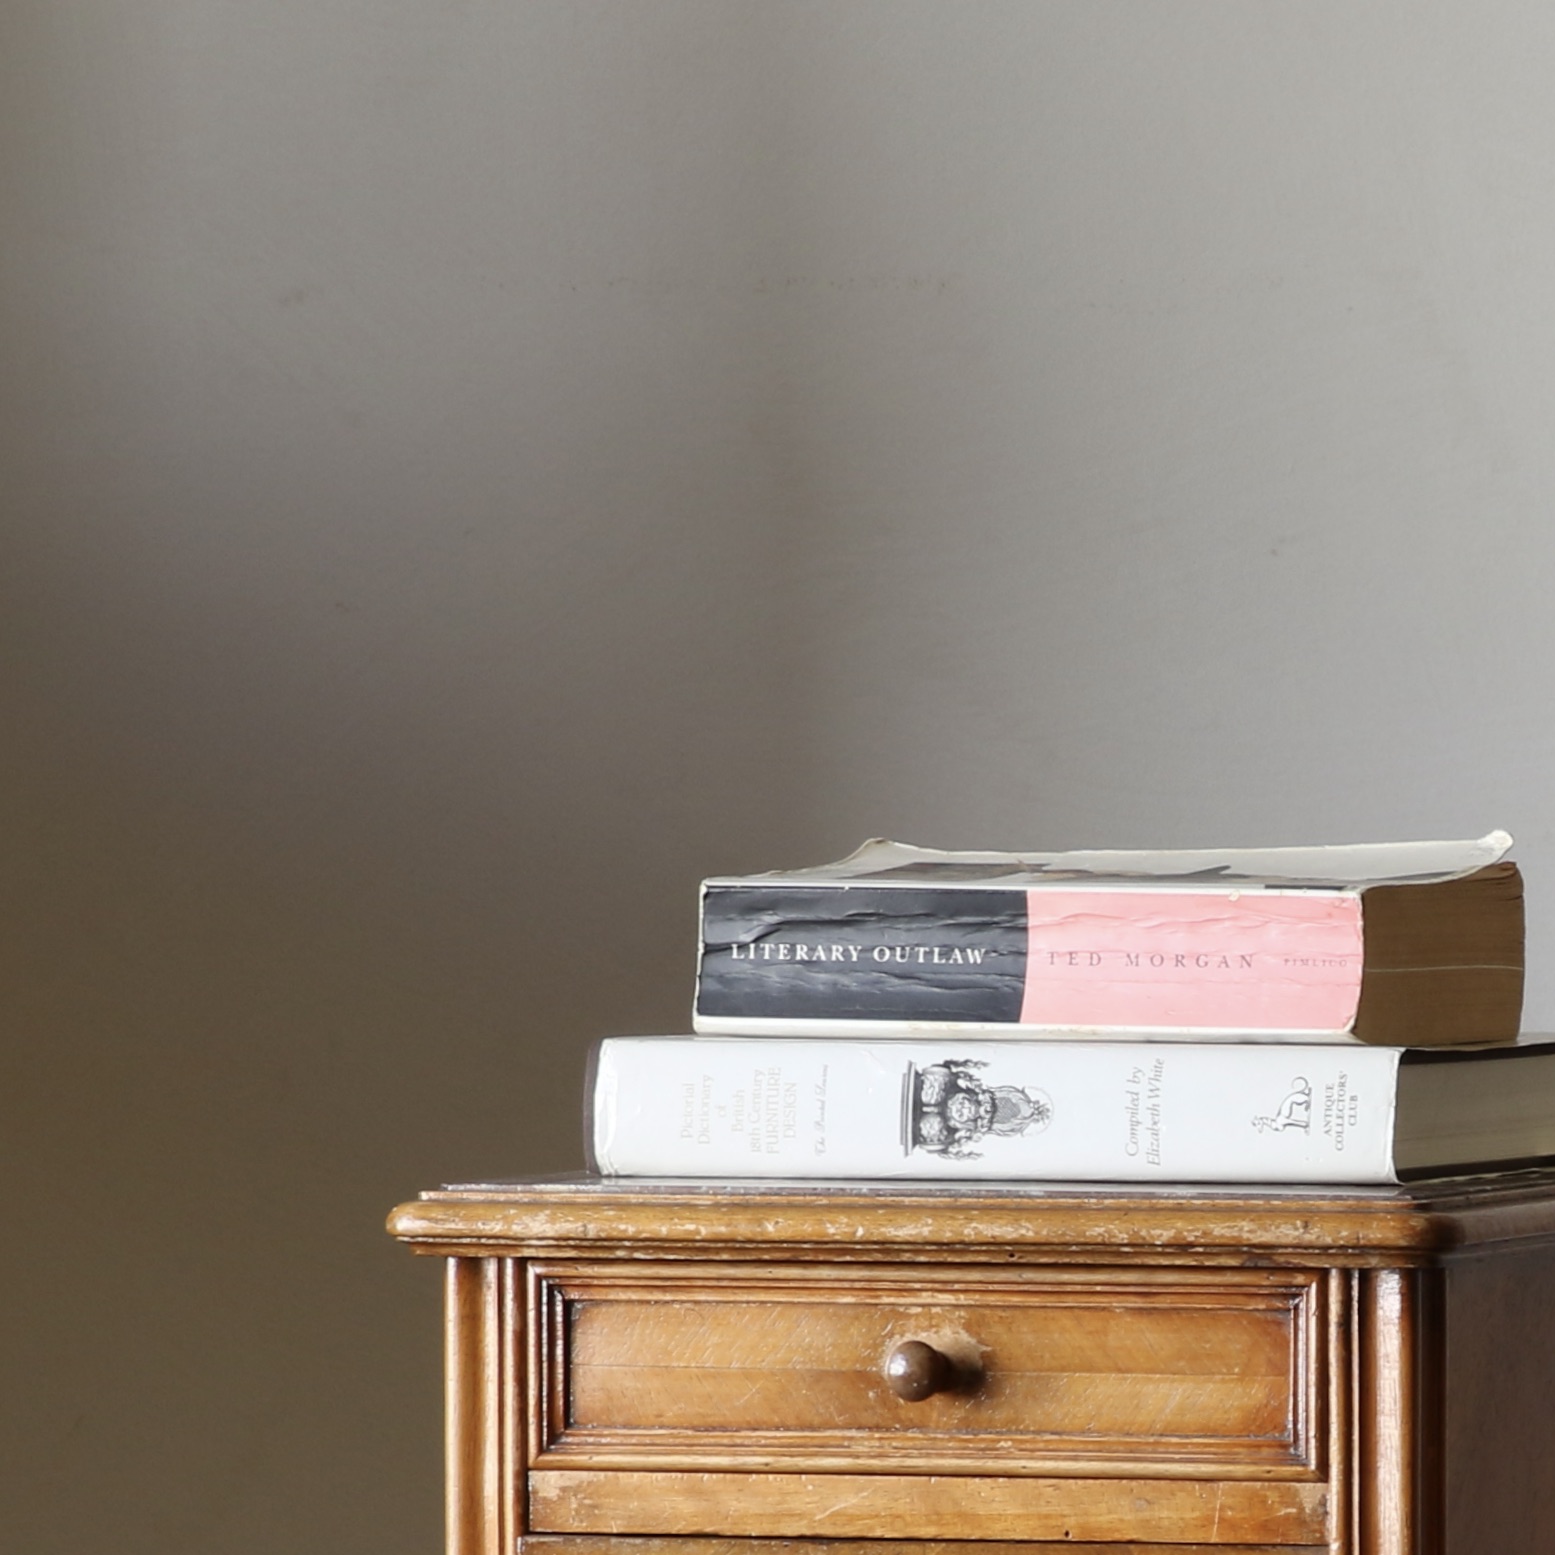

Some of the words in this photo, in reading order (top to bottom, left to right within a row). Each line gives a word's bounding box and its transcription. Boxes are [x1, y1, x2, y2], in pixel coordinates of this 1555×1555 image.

[731, 943, 863, 963] LITERARY
[872, 945, 987, 965] OUTLAW
[1046, 951, 1103, 967] TED
[1124, 952, 1255, 969] MORGAN
[1283, 957, 1347, 968] PIMLICO
[748, 1069, 766, 1124] Century
[1126, 1066, 1146, 1084] by
[1147, 1057, 1165, 1099] White
[680, 1083, 695, 1139] Pictorial
[697, 1074, 714, 1145] Dictionary
[714, 1103, 727, 1118] of
[731, 1089, 745, 1133] British
[765, 1067, 782, 1155] FURNITURE
[783, 1082, 797, 1139] DESIGN
[1124, 1090, 1143, 1157] Compiled
[1323, 1083, 1336, 1137] ANTIQUE
[1348, 1094, 1358, 1127] CLUB
[749, 1127, 762, 1153] 18th
[1145, 1103, 1161, 1167] Elizabeth
